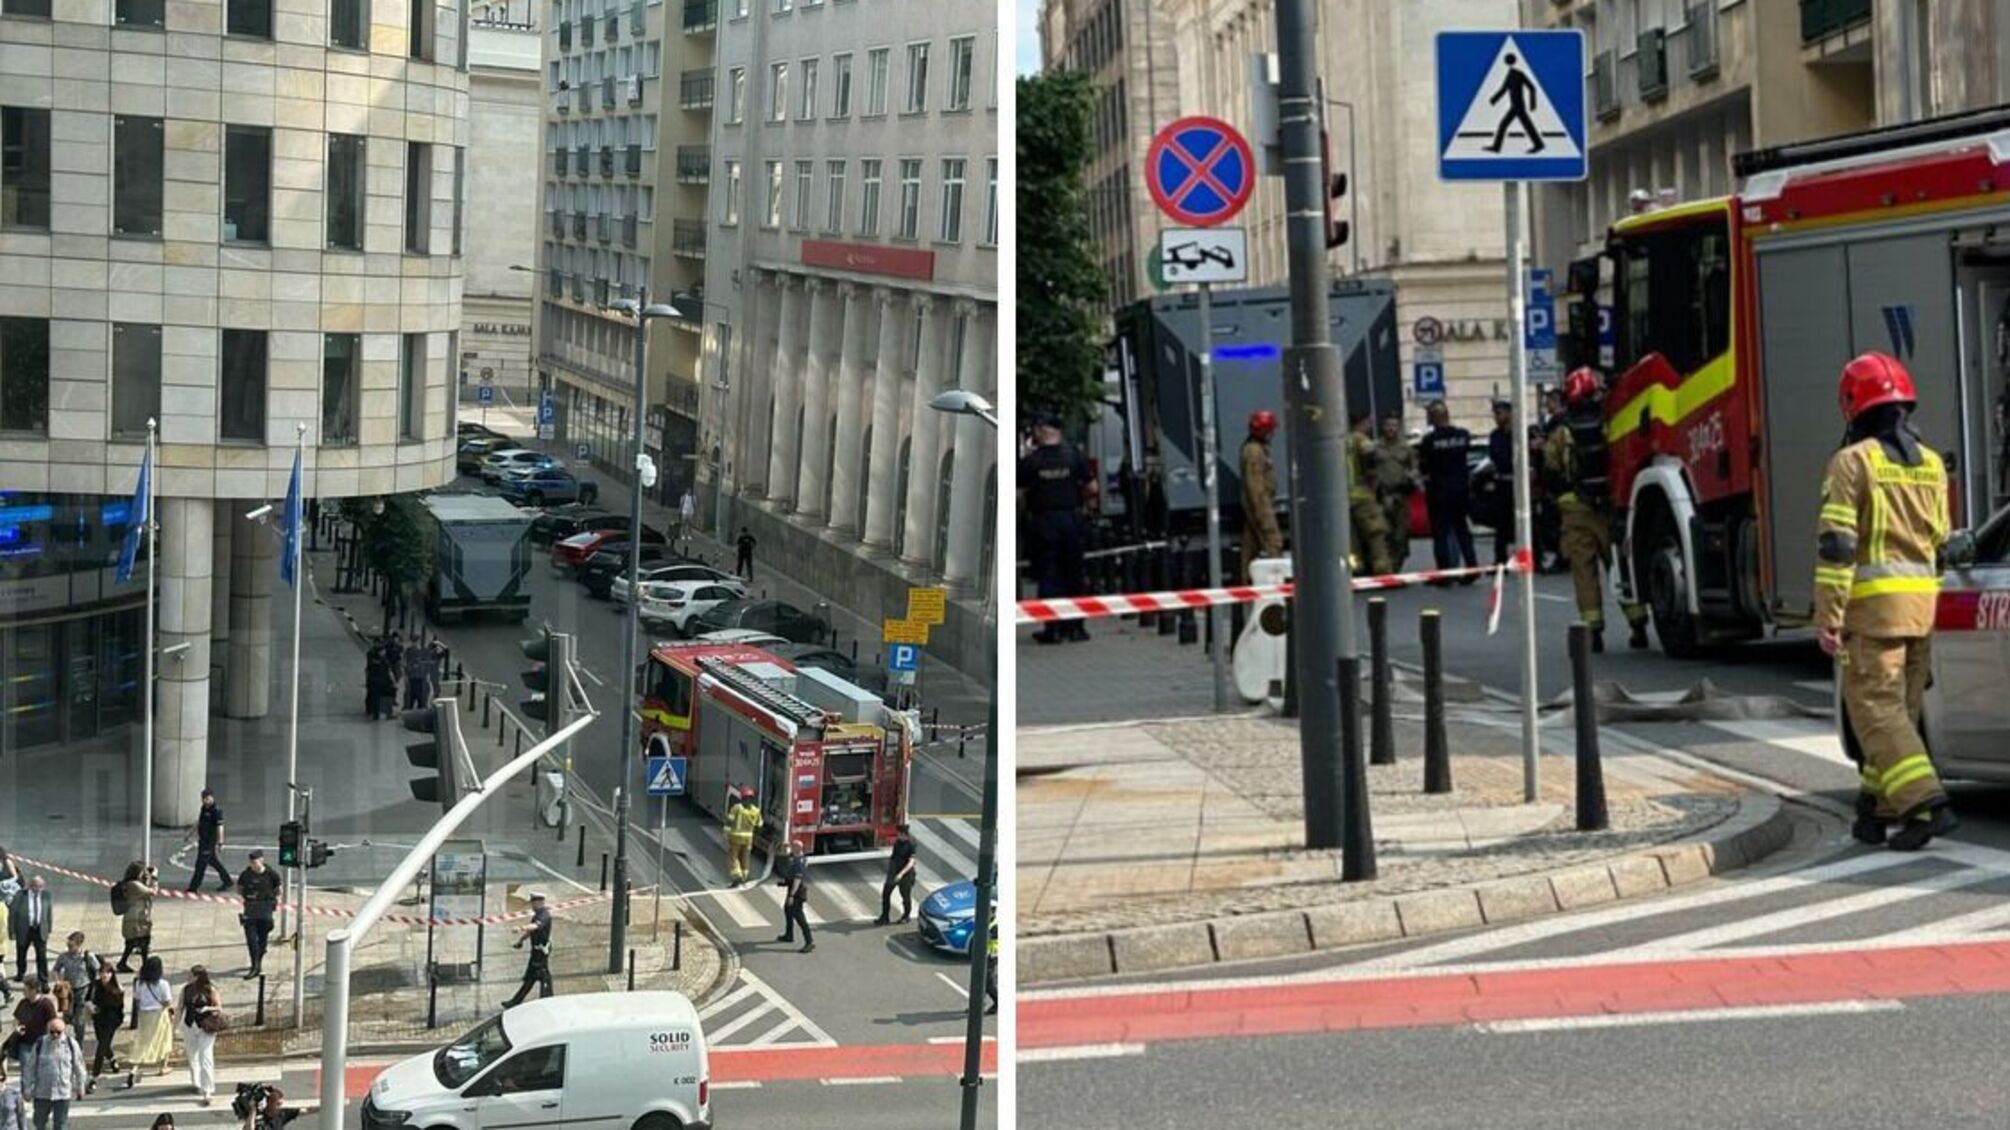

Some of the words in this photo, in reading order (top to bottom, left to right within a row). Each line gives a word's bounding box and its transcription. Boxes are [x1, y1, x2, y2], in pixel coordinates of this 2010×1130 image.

[1528, 308, 1547, 335] P
[1420, 366, 1437, 389] P
[896, 646, 912, 668] P
[650, 1032, 690, 1044] SOLID
